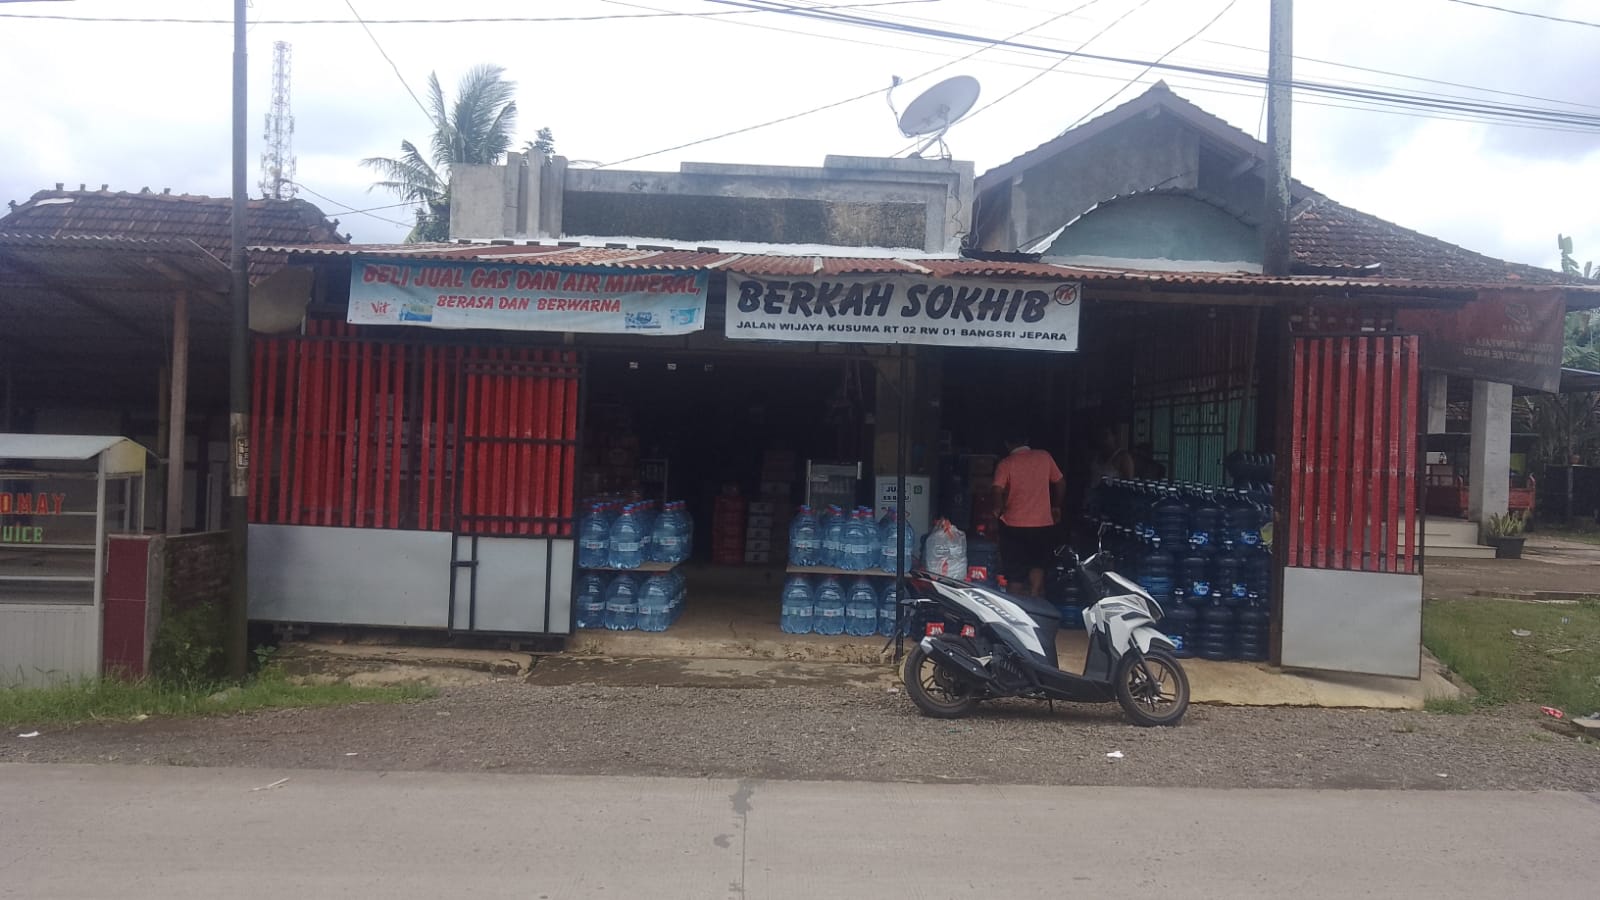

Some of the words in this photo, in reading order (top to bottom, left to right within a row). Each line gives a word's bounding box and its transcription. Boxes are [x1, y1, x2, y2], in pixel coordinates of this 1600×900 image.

[363, 264, 410, 287] BELI
[414, 267, 464, 288] JUAL
[470, 268, 513, 289] GAS
[516, 270, 561, 291] DAN
[562, 273, 601, 292] AIR
[436, 294, 494, 309] BERASA
[498, 296, 530, 311] DAN
[536, 297, 621, 313] BERWARNA
[737, 280, 895, 318] BERKAH
[900, 283, 1050, 323] SOKHIB
[736, 320, 776, 330] JALAN
[779, 322, 824, 332] WIJAYA
[827, 323, 880, 333] KUSUMA
[883, 324, 899, 333] RT
[902, 325, 916, 334] 02
[919, 326, 939, 335] RW
[942, 327, 956, 336] 01
[960, 328, 1016, 338] BANGSRI
[1019, 330, 1067, 341] JEPARA
